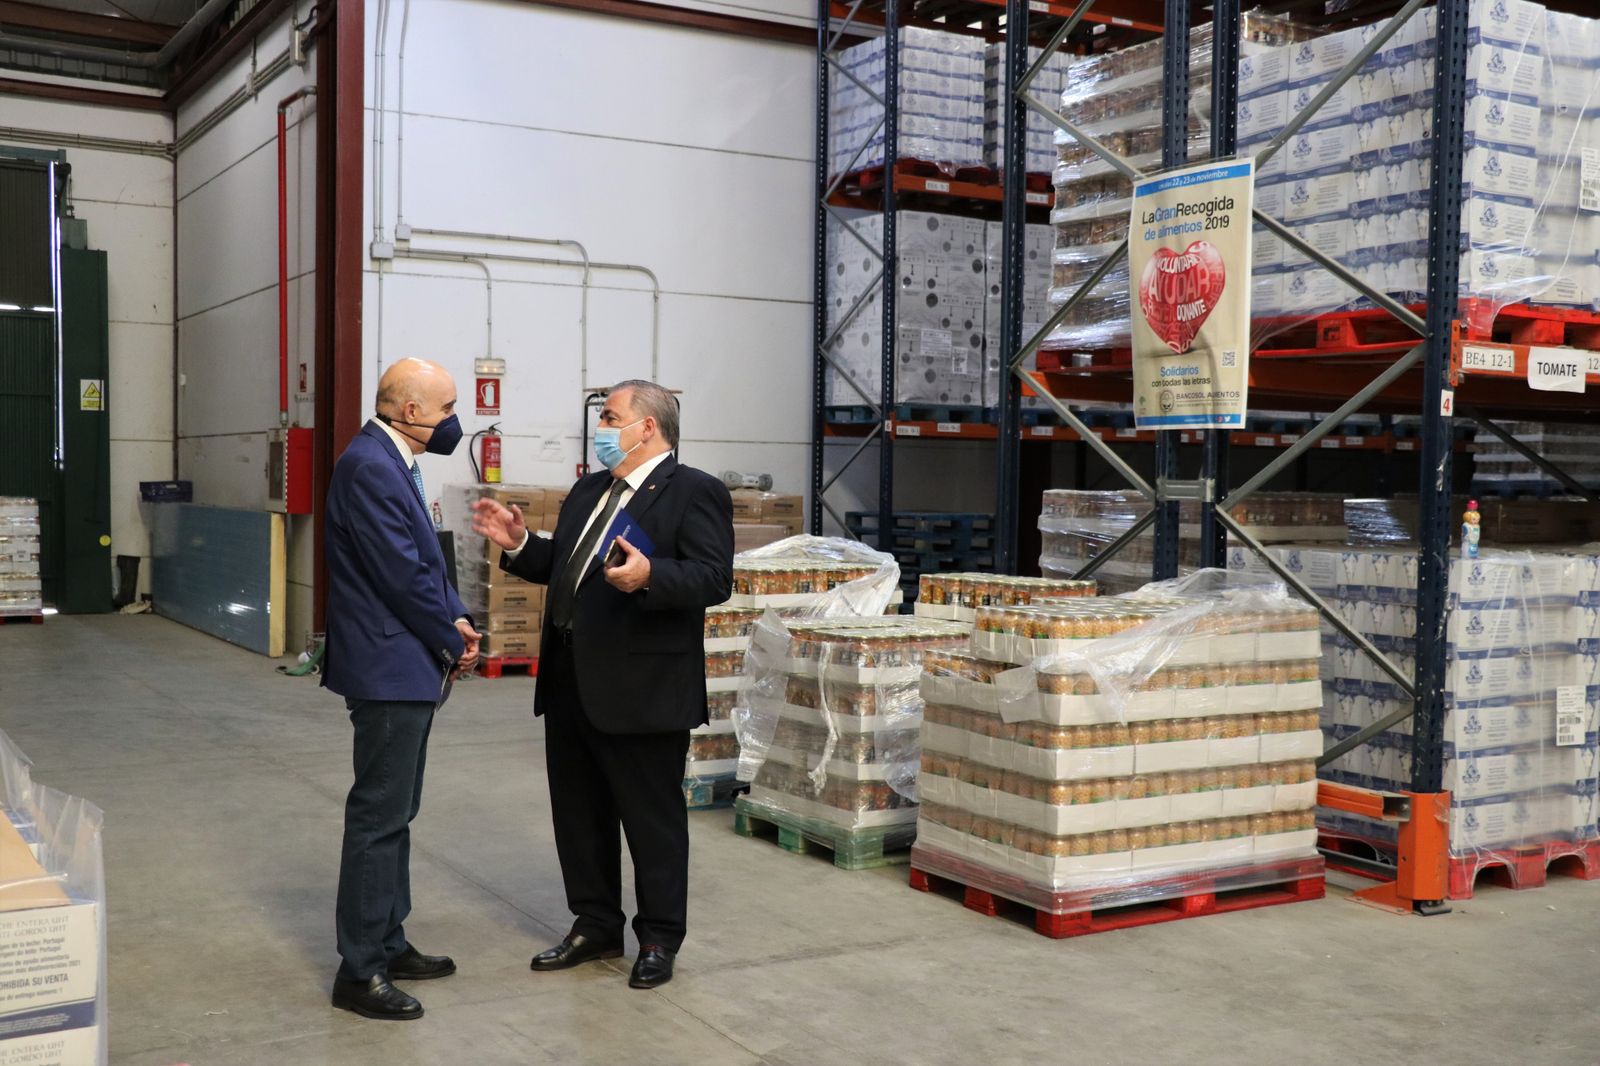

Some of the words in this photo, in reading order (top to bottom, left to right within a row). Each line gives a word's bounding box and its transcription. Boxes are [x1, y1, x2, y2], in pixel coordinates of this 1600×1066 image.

[1196, 170, 1229, 181] noviembre
[1144, 229, 1156, 240] de
[1158, 221, 1202, 238] alimentos
[1205, 215, 1230, 230] 2019
[1148, 263, 1211, 305] AYUDAR
[1177, 299, 1207, 322] DONANTE
[1465, 351, 1485, 366] BE4
[1492, 354, 1512, 368] 12-1
[1160, 366, 1199, 377] Solidarios
[1537, 362, 1577, 377] TOMATE
[1443, 398, 1450, 412] 4
[32, 976, 43, 987] SU
[44, 973, 69, 985] VENTA
